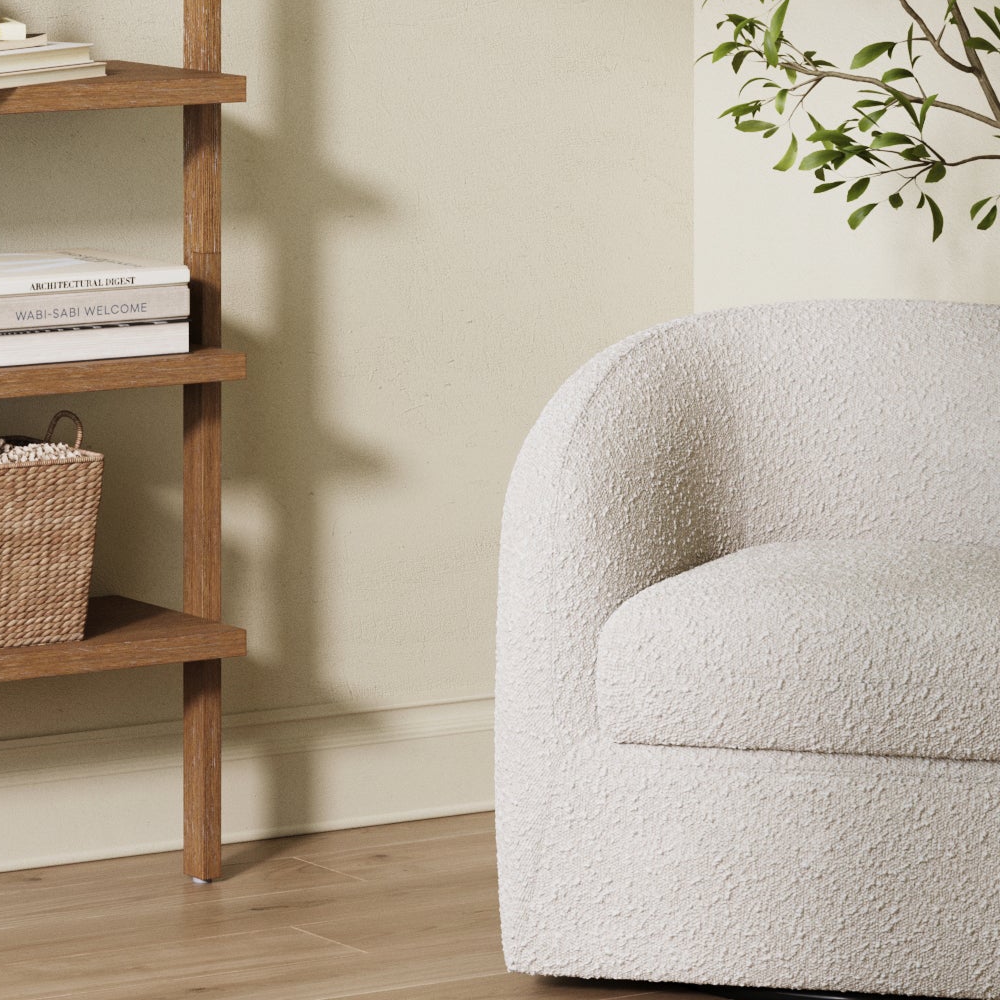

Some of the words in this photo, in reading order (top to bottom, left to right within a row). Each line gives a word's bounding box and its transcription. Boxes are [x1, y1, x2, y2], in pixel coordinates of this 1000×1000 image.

[30, 278, 103, 291] ARCHITECTURAL
[105, 276, 136, 287] DIGEST
[15, 308, 80, 321] WABI-SABI
[84, 302, 148, 317] WELCOME
